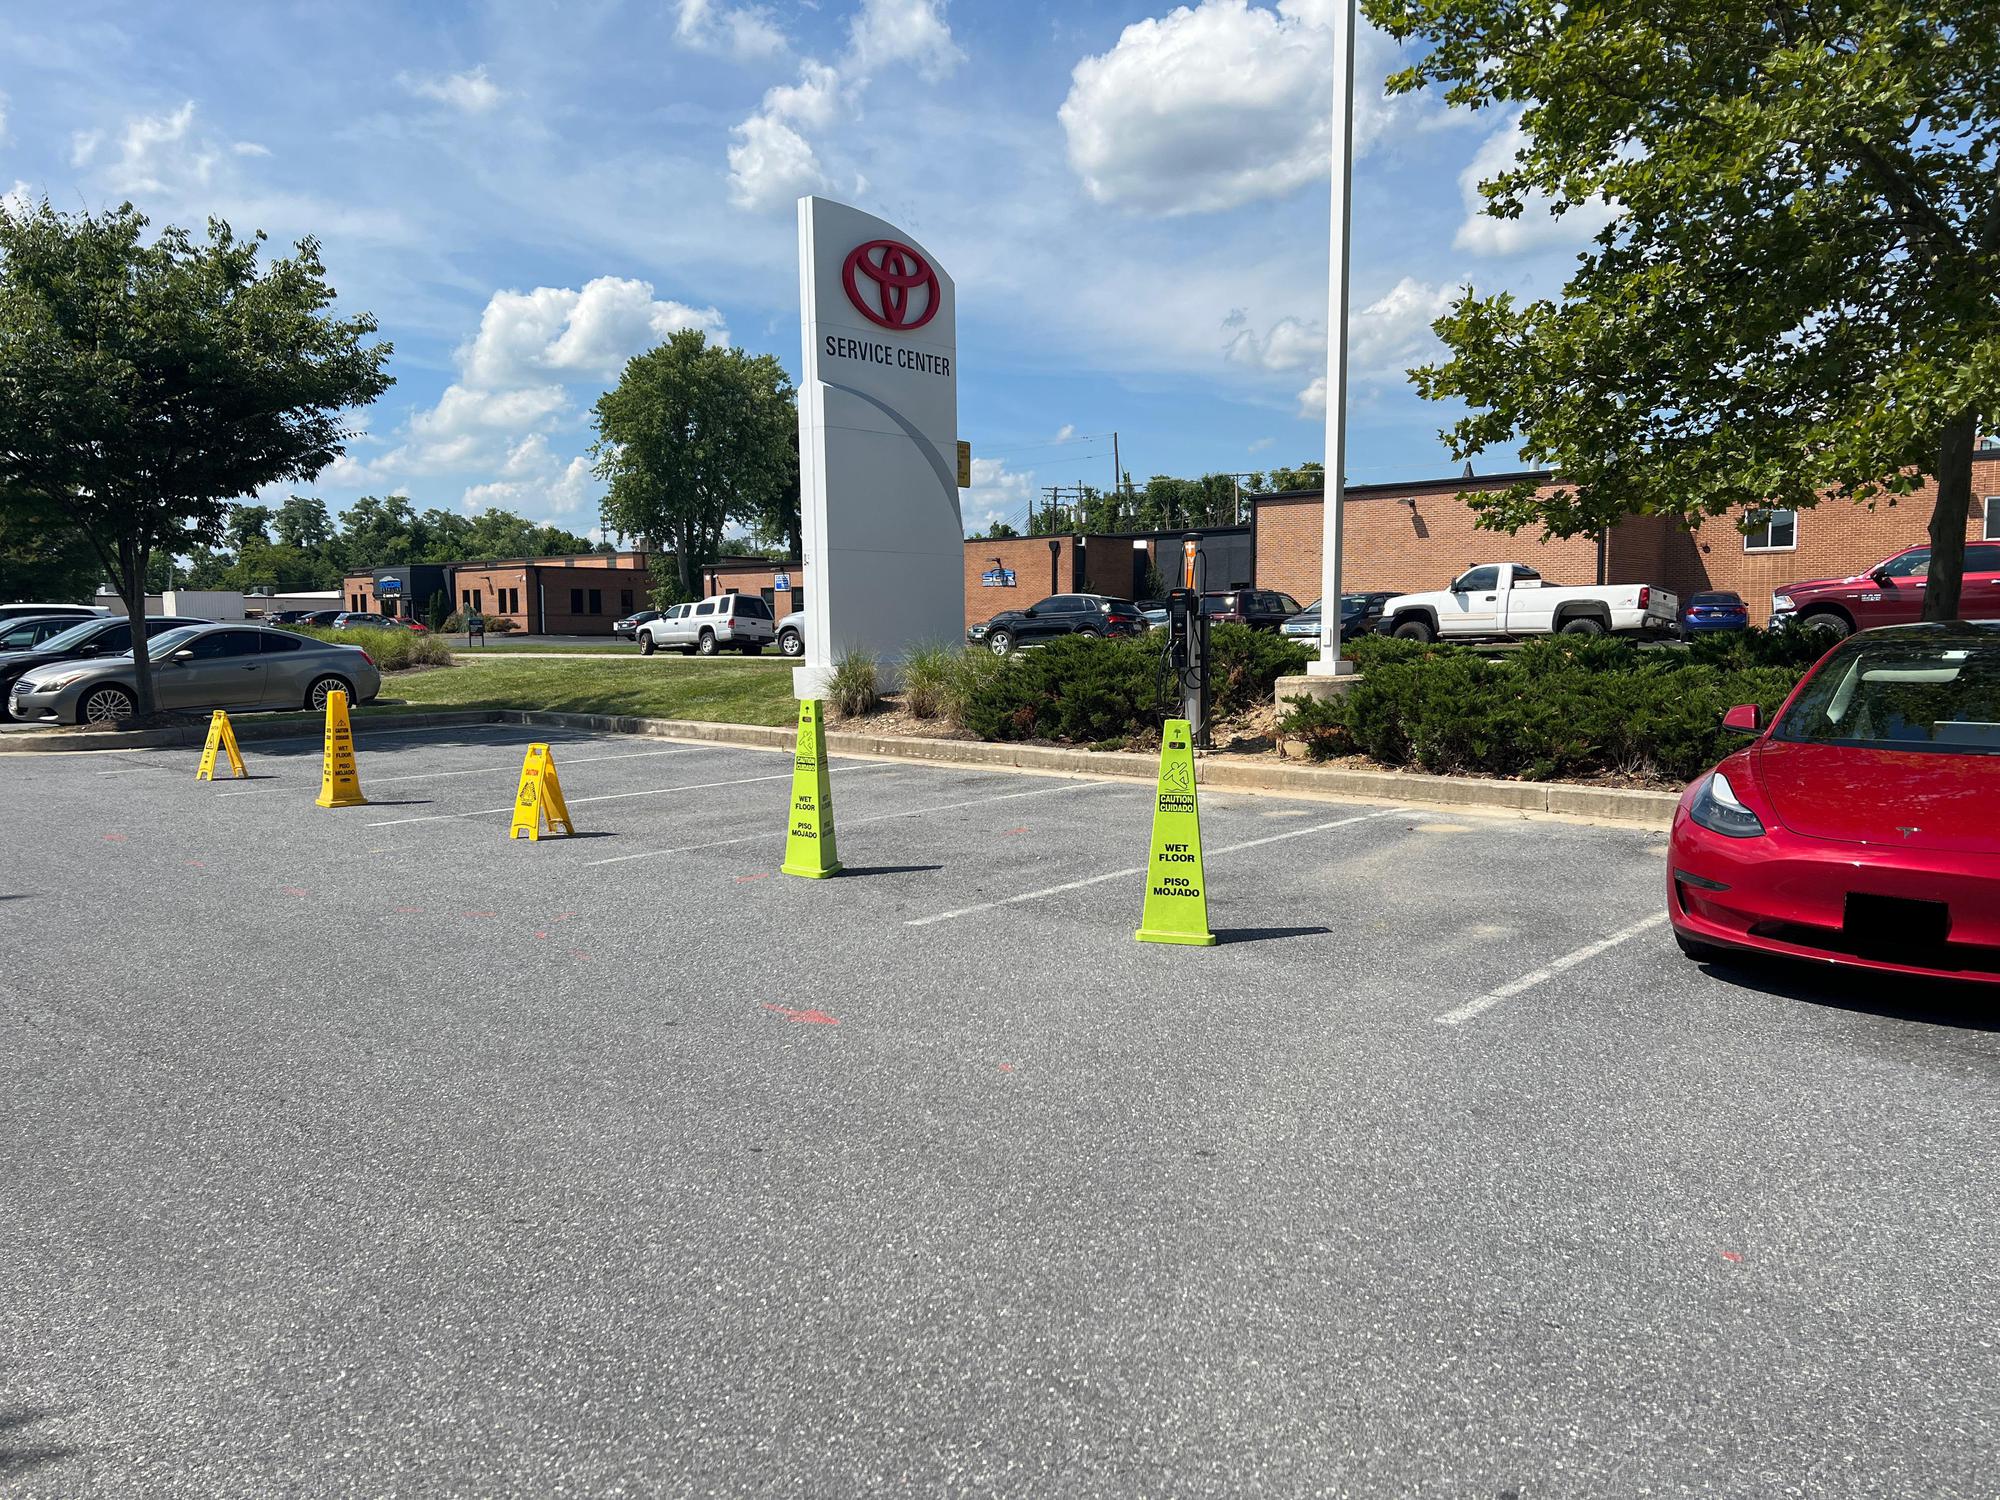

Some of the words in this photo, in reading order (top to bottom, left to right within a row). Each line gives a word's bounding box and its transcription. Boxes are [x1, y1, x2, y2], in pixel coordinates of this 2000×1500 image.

[825, 335, 893, 366] SERVICE
[897, 348, 950, 377] CENTER
[798, 795, 812, 803] WET
[1160, 794, 1194, 804] CAUTION
[795, 803, 816, 811] FLOOR
[1159, 803, 1194, 812] CUIDADO
[797, 822, 812, 830] PISO
[791, 829, 817, 839] MOJADO
[1164, 843, 1189, 853] WET
[1158, 853, 1195, 863] FLOOR
[1163, 877, 1190, 887] PISO
[1153, 887, 1200, 897] MOJADO
